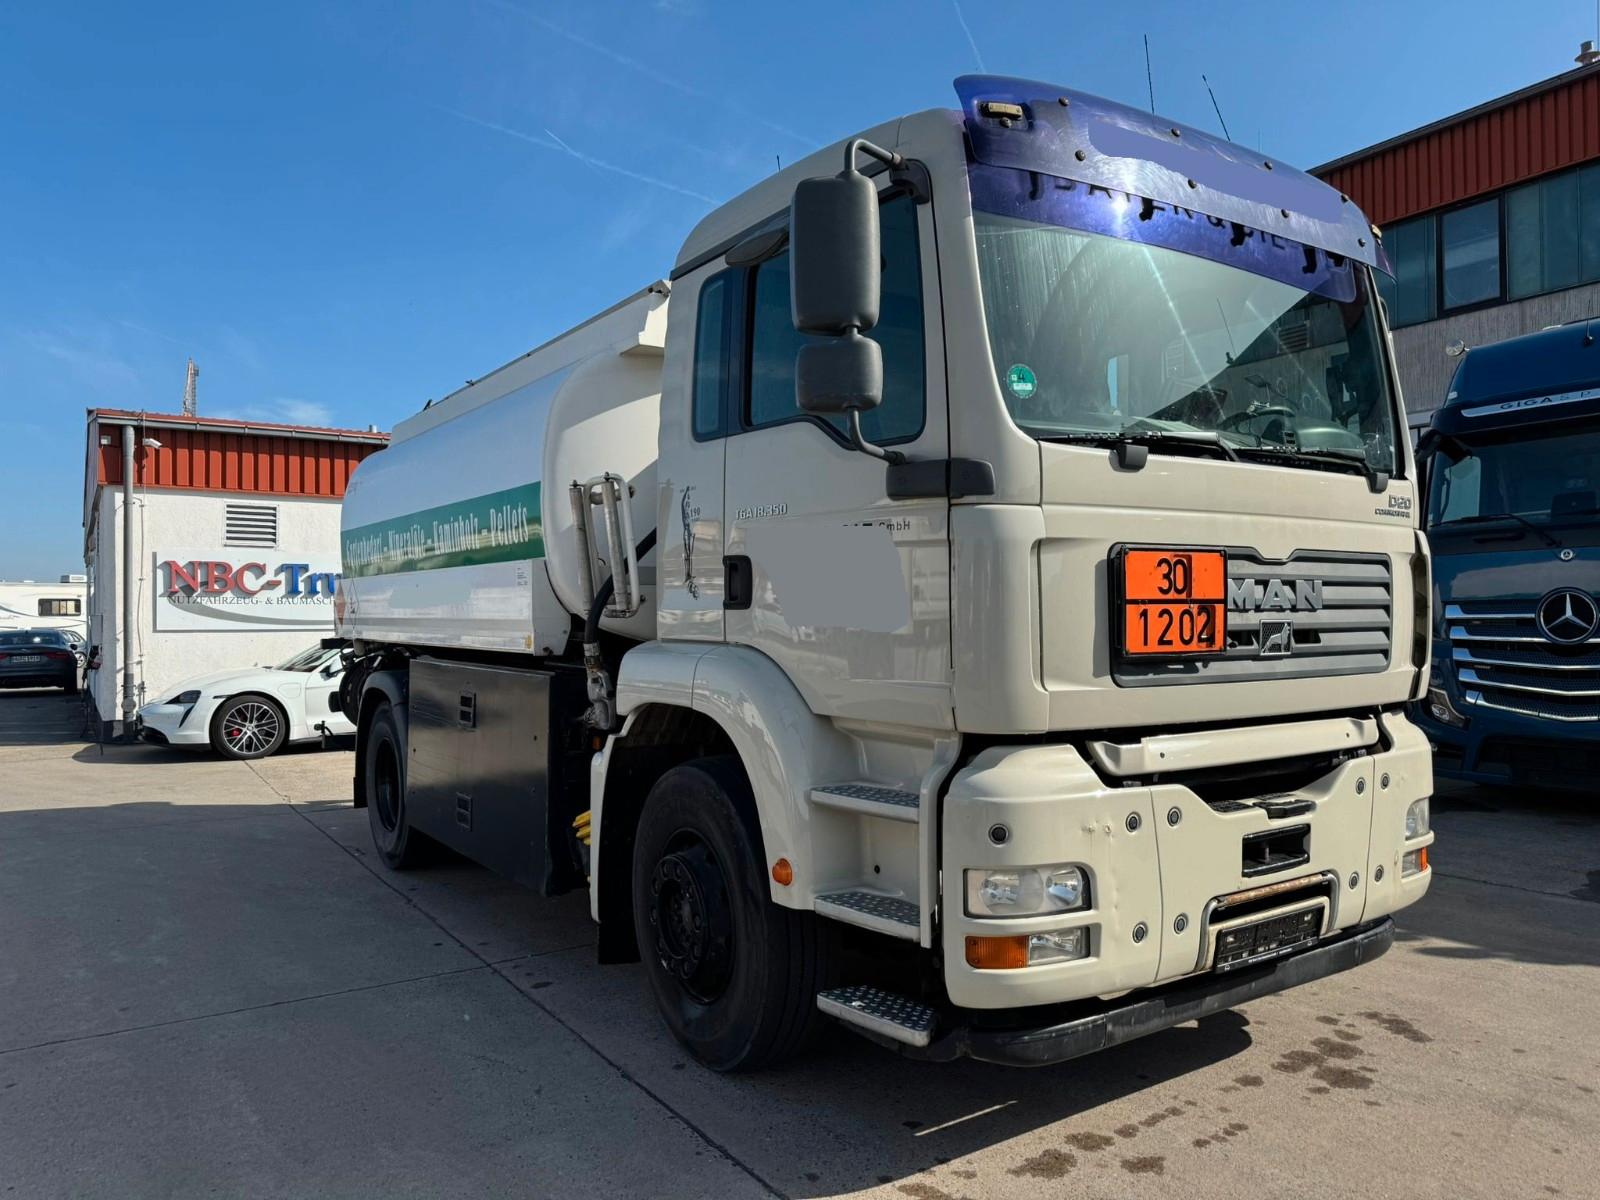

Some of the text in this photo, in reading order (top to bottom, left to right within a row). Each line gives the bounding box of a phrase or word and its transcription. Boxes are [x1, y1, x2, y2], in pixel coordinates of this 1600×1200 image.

[433, 512, 480, 554] Kaminholz
[489, 502, 529, 548] Pellets
[1156, 557, 1188, 595] 30
[1227, 578, 1323, 611] MAN
[265, 595, 274, 606] &
[1139, 608, 1215, 647] 1202
